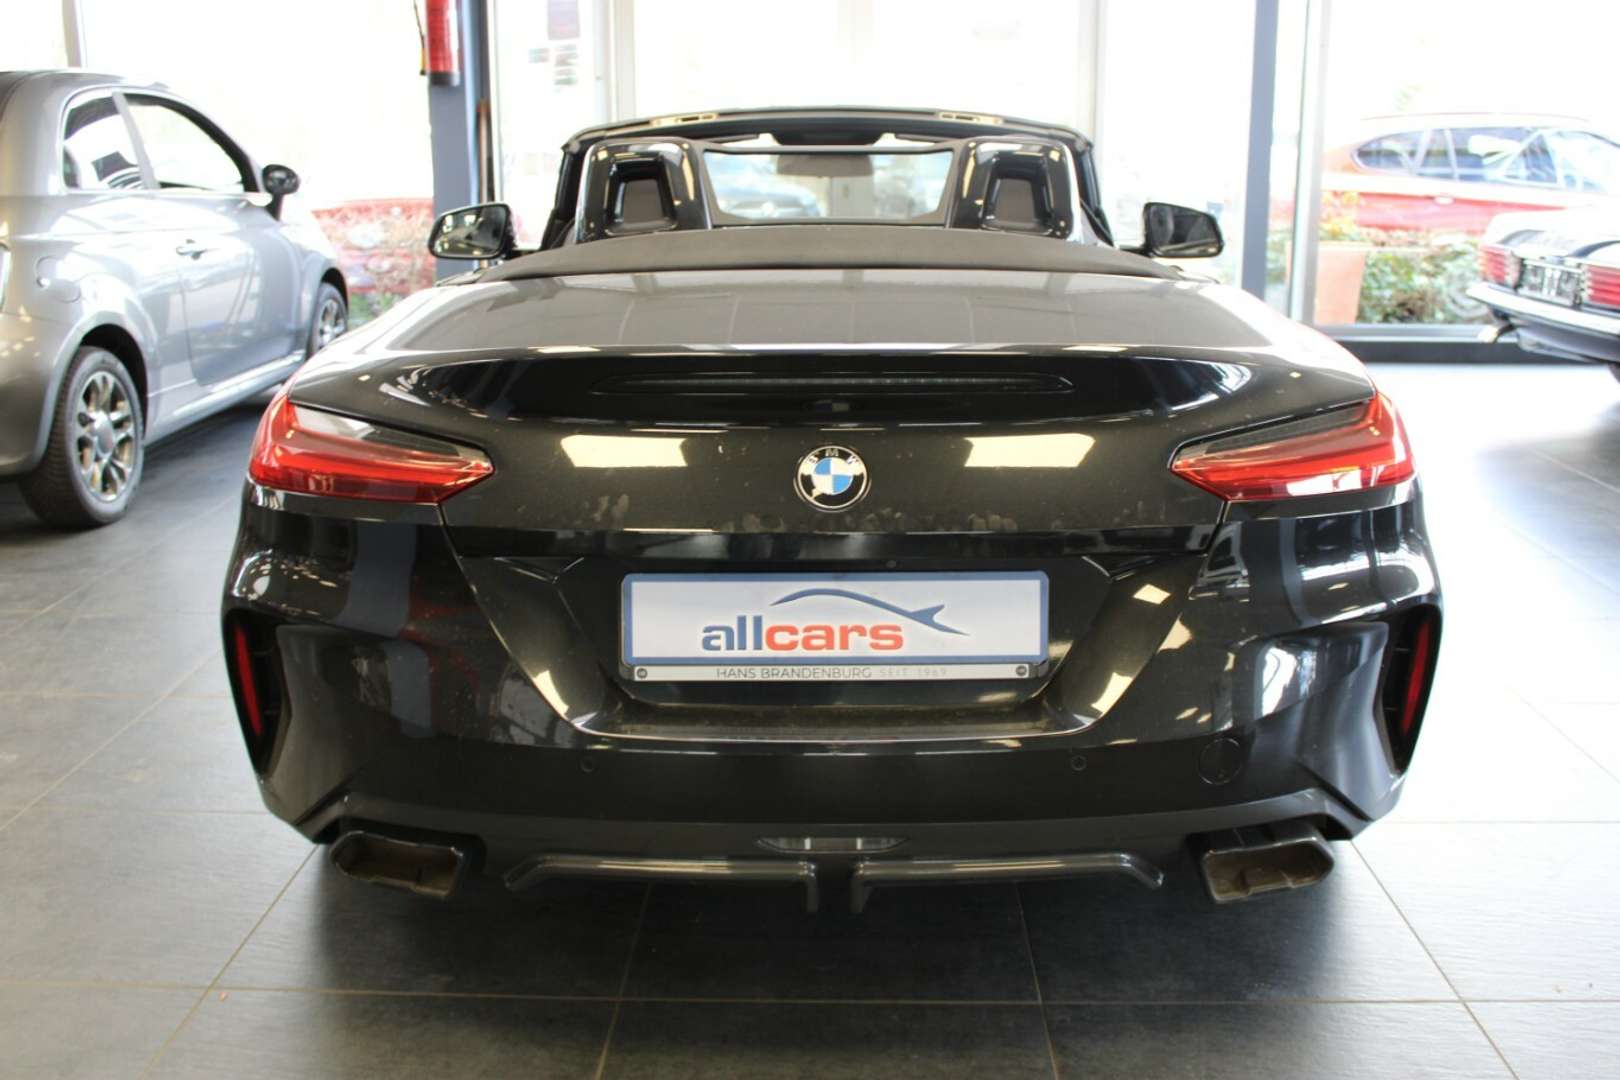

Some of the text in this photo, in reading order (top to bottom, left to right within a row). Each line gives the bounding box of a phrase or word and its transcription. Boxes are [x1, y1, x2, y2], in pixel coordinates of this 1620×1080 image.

[702, 615, 904, 651] allcars
[716, 668, 756, 679] HANS
[761, 667, 872, 679] BRANDENBURG
[880, 667, 910, 678] SEIT
